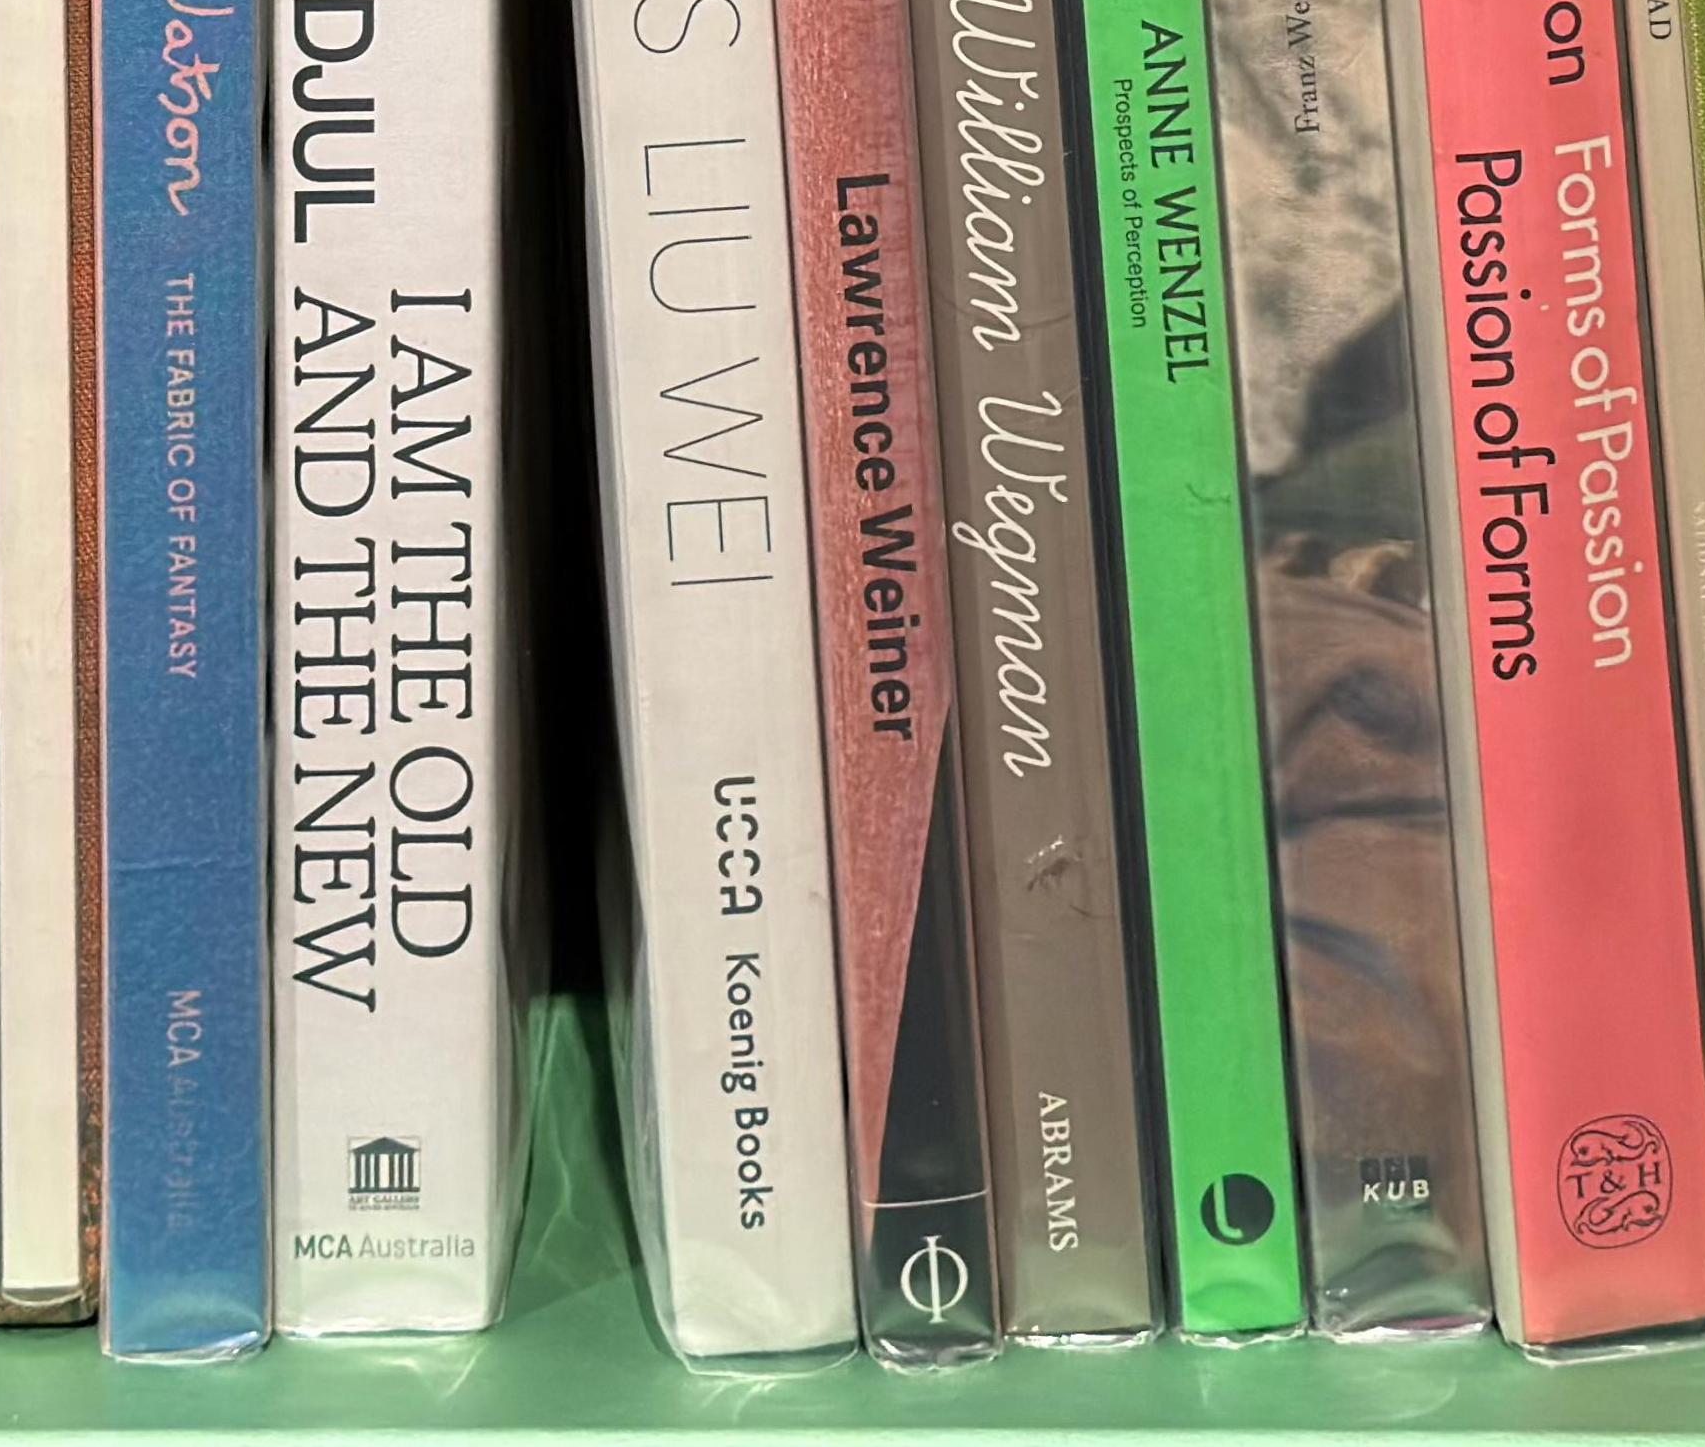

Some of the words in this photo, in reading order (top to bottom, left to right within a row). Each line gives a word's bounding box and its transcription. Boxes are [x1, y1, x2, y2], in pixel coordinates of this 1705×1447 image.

[1111, 78, 1138, 182] Prospects
[1139, 19, 1193, 170] ANNE
[1295, 55, 1320, 133] Franz
[644, 138, 758, 314] LIU
[1118, 189, 1141, 208] of
[1118, 215, 1150, 329] Perception
[1455, 150, 1531, 391] Passion
[1552, 135, 1619, 333] Forms
[167, 274, 196, 336] THE
[390, 288, 470, 317] I
[836, 173, 902, 492] Lawrence
[1153, 187, 1209, 385] WENZEL
[166, 349, 196, 466] FABRIC
[292, 284, 374, 518] AND
[390, 334, 474, 500] AM
[1476, 401, 1555, 469] of
[1568, 349, 1634, 420] of
[168, 478, 196, 520] OF
[659, 358, 775, 588] WEI
[168, 535, 196, 678] FANTASY
[1479, 481, 1549, 682] Forms
[1575, 425, 1643, 669] Passion
[294, 544, 376, 740] THE
[391, 522, 474, 725] THE
[857, 504, 921, 743] Weiner
[294, 759, 376, 1013] NEW
[391, 744, 474, 959] OLD
[715, 777, 763, 918] UCCA
[953, 389, 1069, 776] Wegman
[1039, 1091, 1079, 1251] ABRAMS
[167, 990, 202, 1067] MCA
[721, 952, 764, 1093] Koenig
[735, 1106, 774, 1230] Books
[1363, 1179, 1430, 1203] KUB
[294, 1234, 352, 1259] MCA
[359, 1234, 475, 1259] Australia
